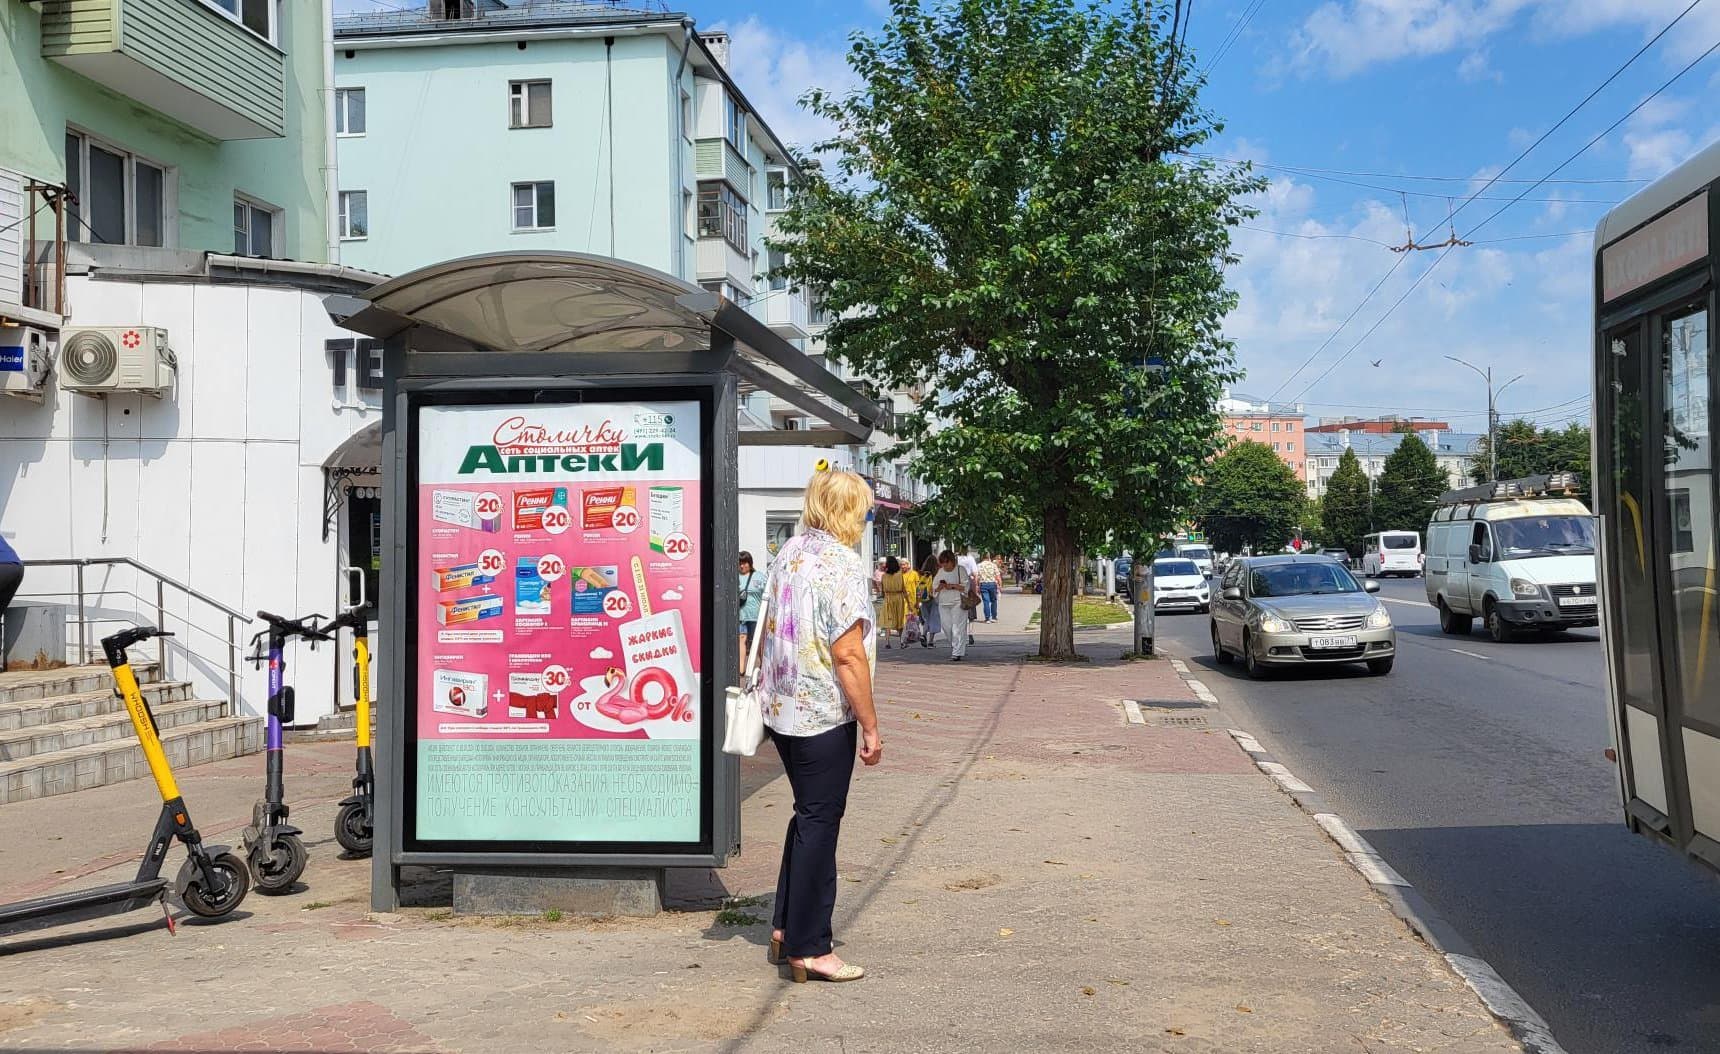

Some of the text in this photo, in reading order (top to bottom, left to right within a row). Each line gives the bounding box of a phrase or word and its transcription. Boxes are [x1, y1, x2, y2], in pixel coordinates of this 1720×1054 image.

[493, 416, 629, 446] Столички
[501, 446, 620, 456] сеть социальных аптек
[628, 626, 674, 646] ЖАРКИЕ
[632, 645, 678, 664] СКИДКИ
[130, 694, 150, 730] WHOOSH
[427, 774, 484, 793] ИМЕЮТСЯ
[427, 797, 693, 819] ПОЛУЧЕНИЕ КОНСУЛЬТАЦИИ СПЕЦИАЛИСТА
